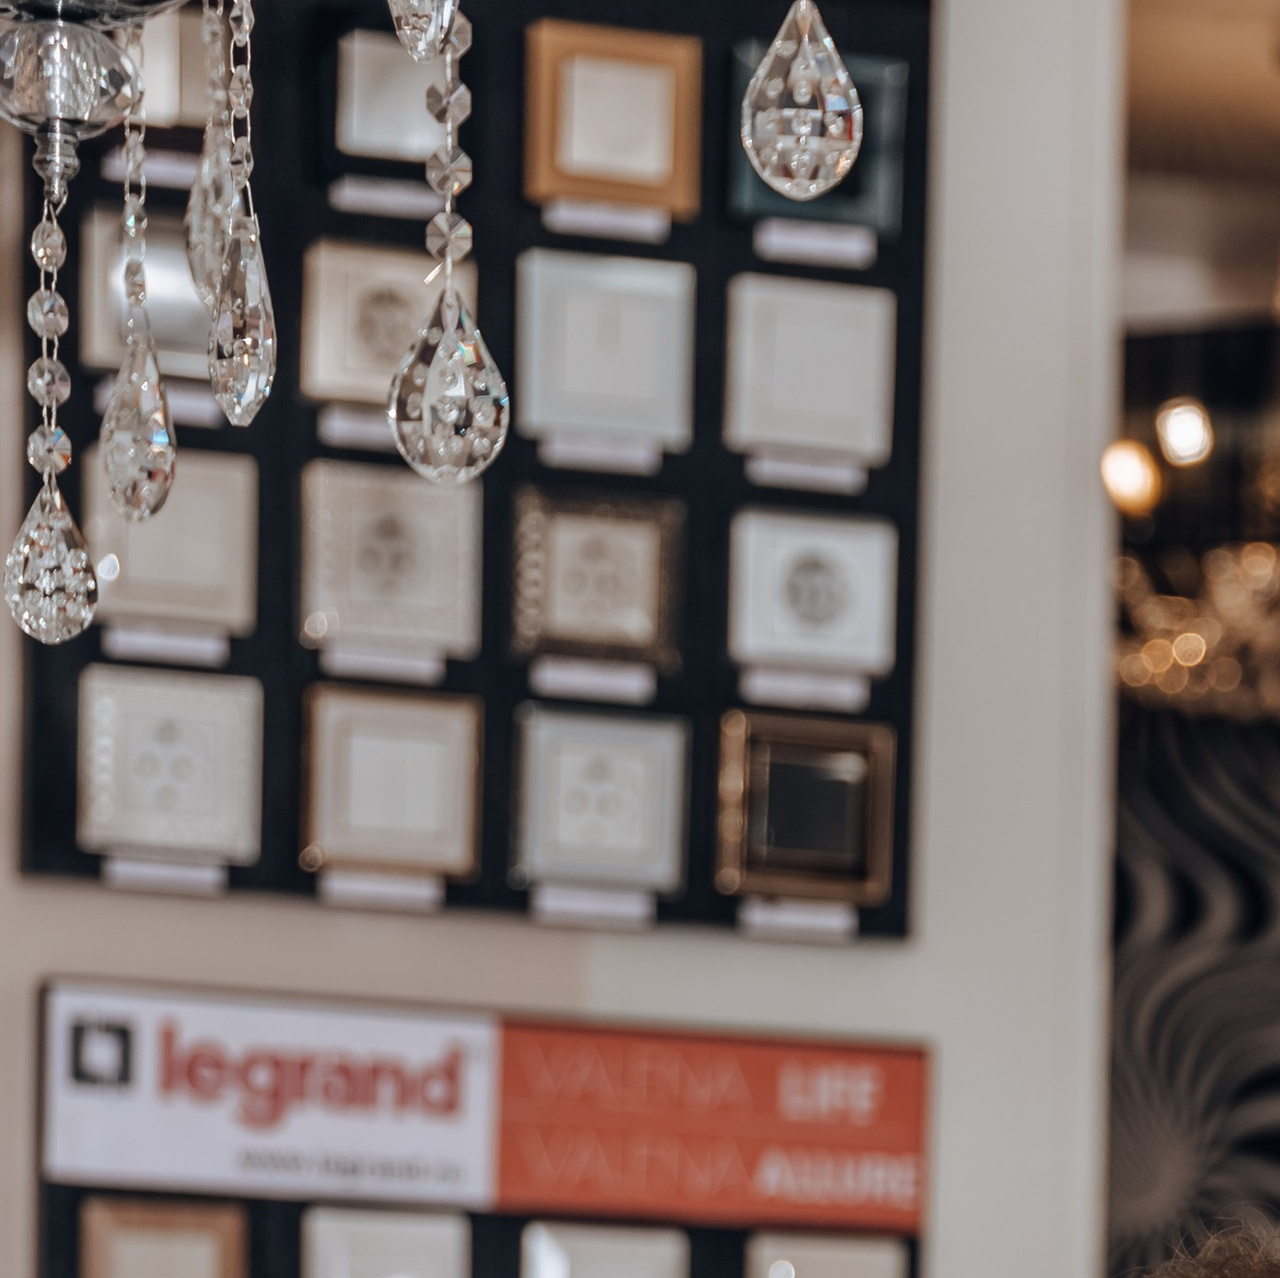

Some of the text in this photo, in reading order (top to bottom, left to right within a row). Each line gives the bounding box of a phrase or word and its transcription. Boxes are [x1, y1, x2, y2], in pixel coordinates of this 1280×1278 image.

[160, 1017, 465, 1128] legrand
[778, 1058, 882, 1126] LIFE
[754, 1147, 920, 1209] ALLURE
